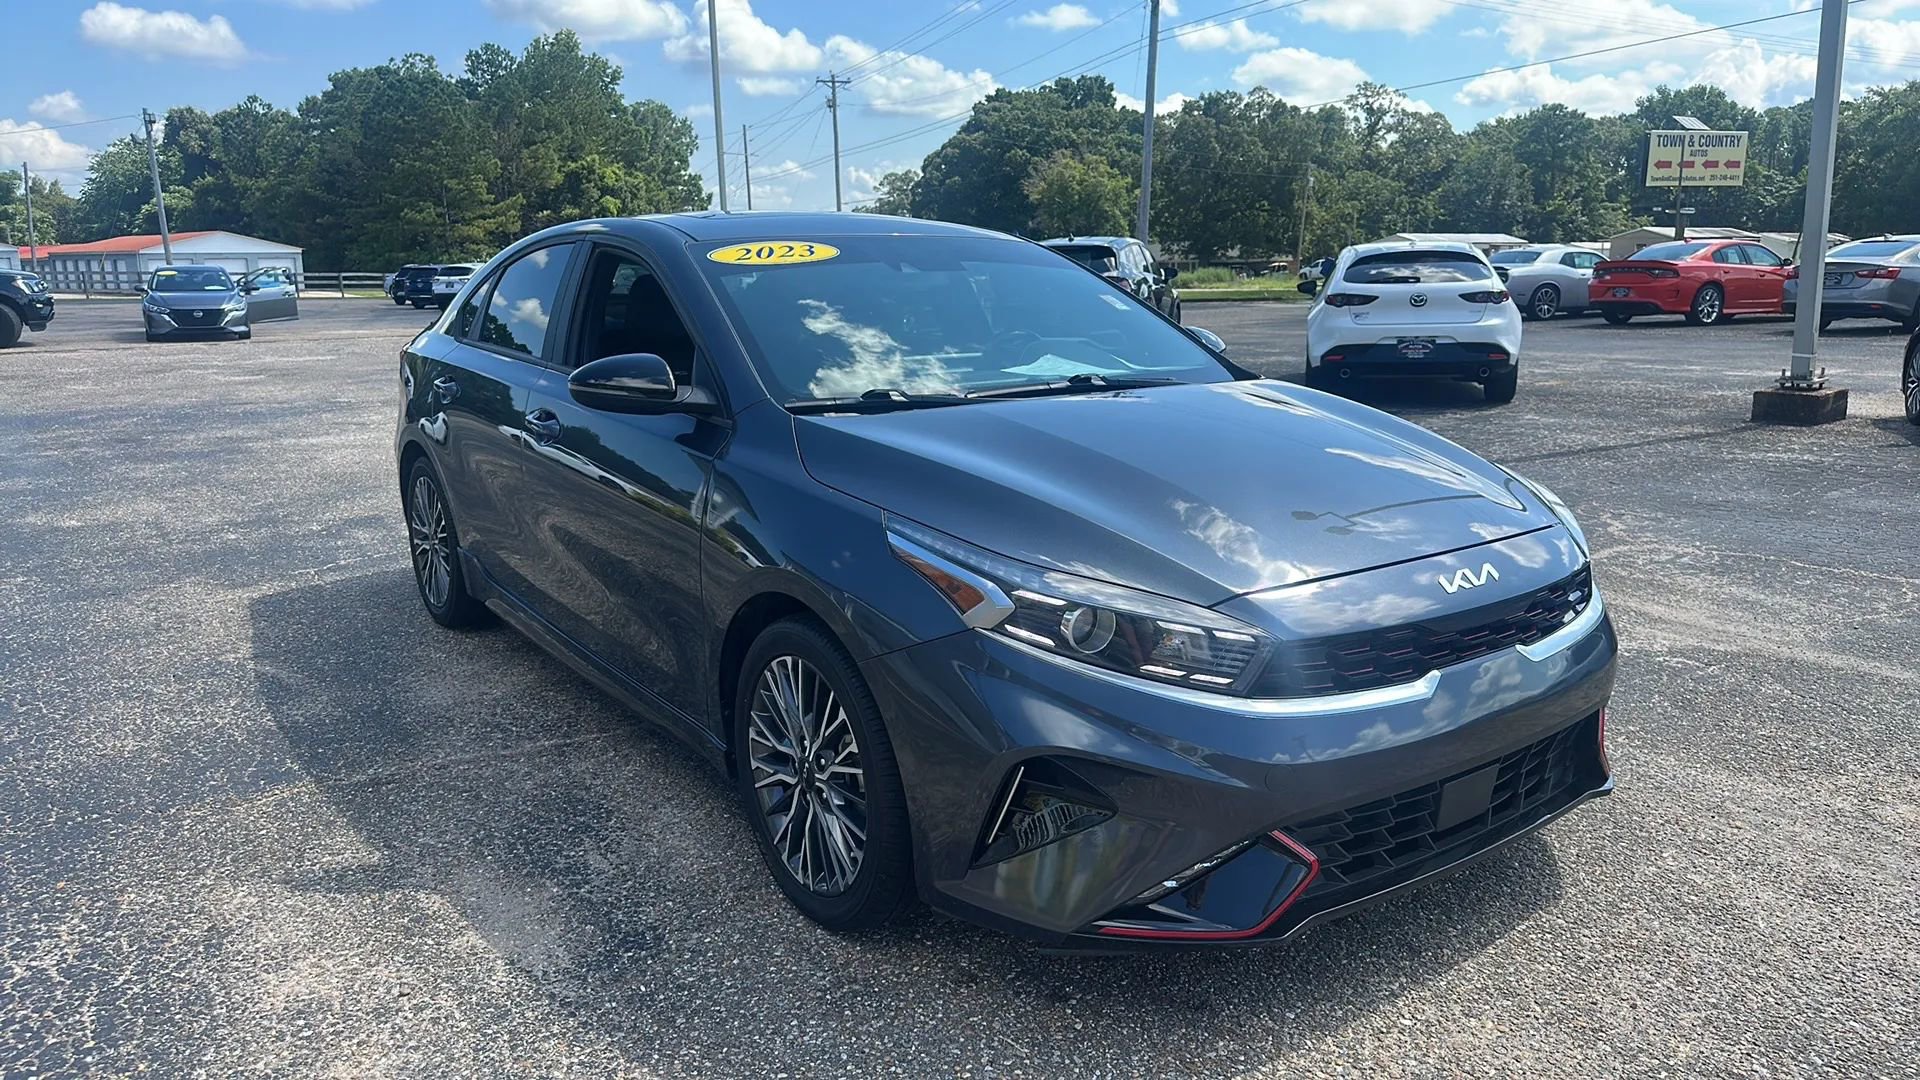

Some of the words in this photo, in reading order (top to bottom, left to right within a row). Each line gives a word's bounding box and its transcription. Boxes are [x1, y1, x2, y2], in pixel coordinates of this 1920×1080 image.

[1687, 134, 1695, 148] &
[1698, 134, 1742, 148] COUNTRY
[1689, 149, 1708, 158] AUTOS
[735, 244, 815, 261] 2023
